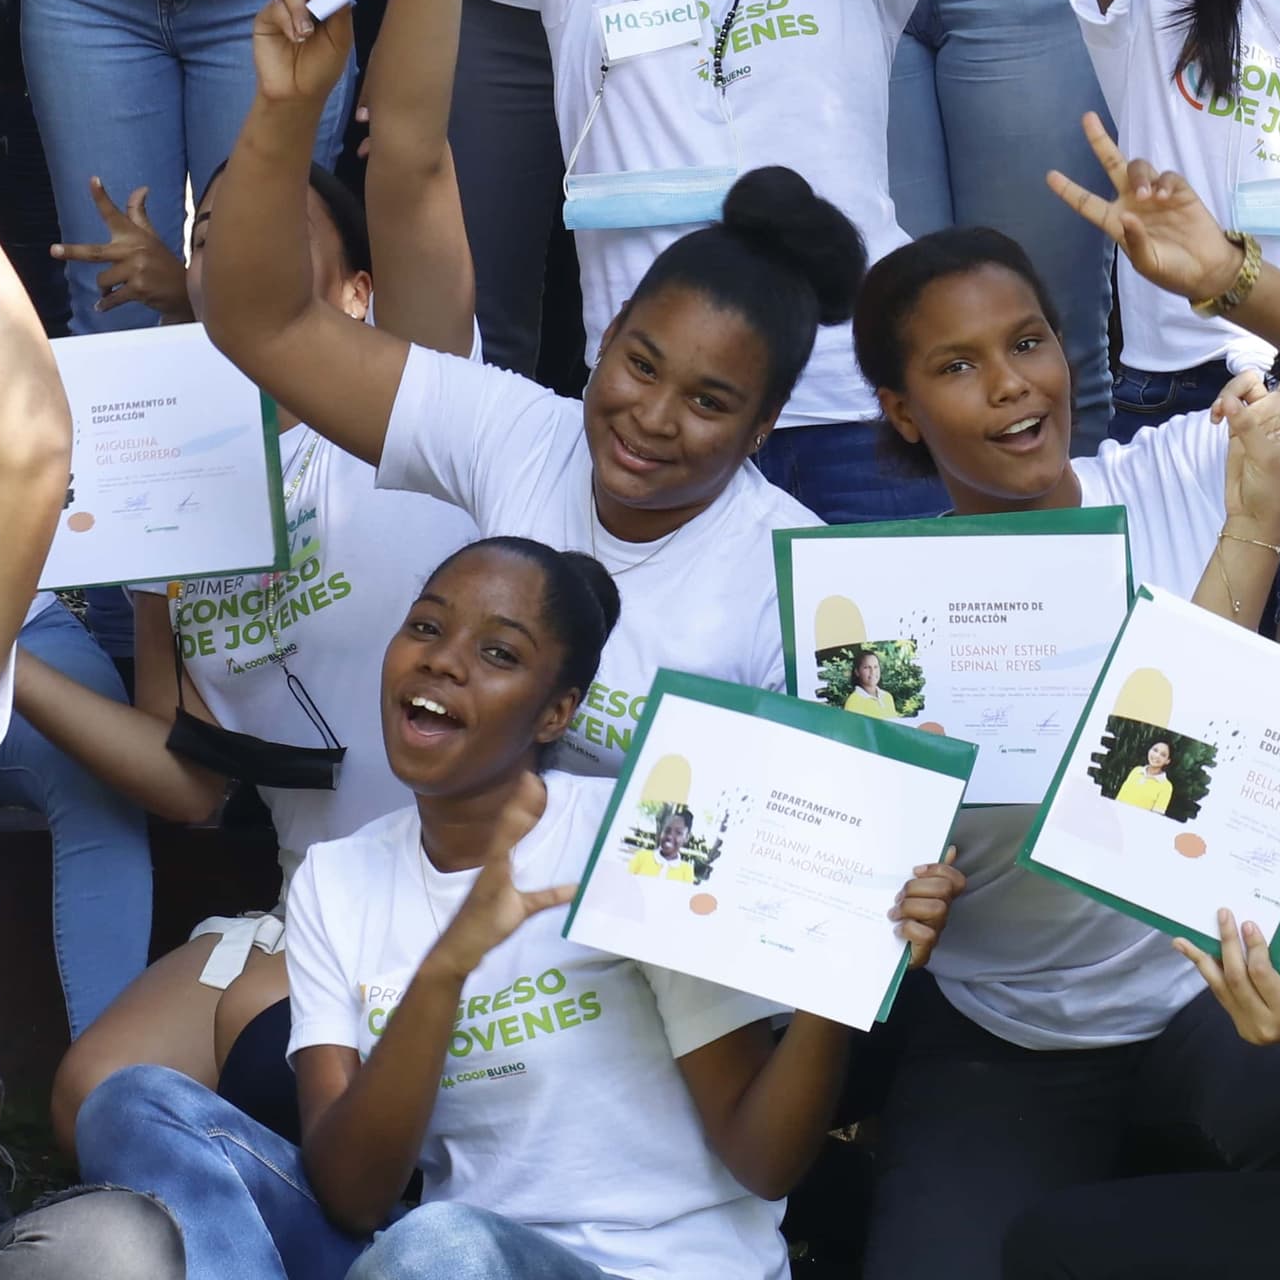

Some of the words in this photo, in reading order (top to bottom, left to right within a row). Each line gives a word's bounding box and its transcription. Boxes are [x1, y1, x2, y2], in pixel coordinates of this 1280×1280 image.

[91, 398, 164, 414] DEPARTAMENTO
[165, 397, 177, 406] DE
[92, 411, 145, 424] EDUCACIÓN
[95, 436, 159, 452] MIGUELINA
[96, 454, 113, 466] GIL
[120, 447, 181, 464] GUERRERO
[949, 602, 1029, 611] DEPARTAMENTO
[1032, 602, 1043, 611] DE
[949, 614, 1007, 624] EDUCACIÓN
[182, 630, 216, 659] DE
[950, 645, 1008, 657] LUSANNY
[1014, 644, 1057, 657] ESTHER
[951, 660, 999, 672] ESPINAL
[1006, 660, 1041, 671] REYES
[766, 801, 822, 825] EDUCACIÓN
[770, 790, 848, 821] DEPARTAMENTO
[849, 816, 862, 827] DE
[749, 843, 782, 863] TAPIA
[788, 856, 854, 885] MONCIÓN
[815, 850, 874, 877] MANUELA
[456, 1061, 526, 1084] COOPBUENO
